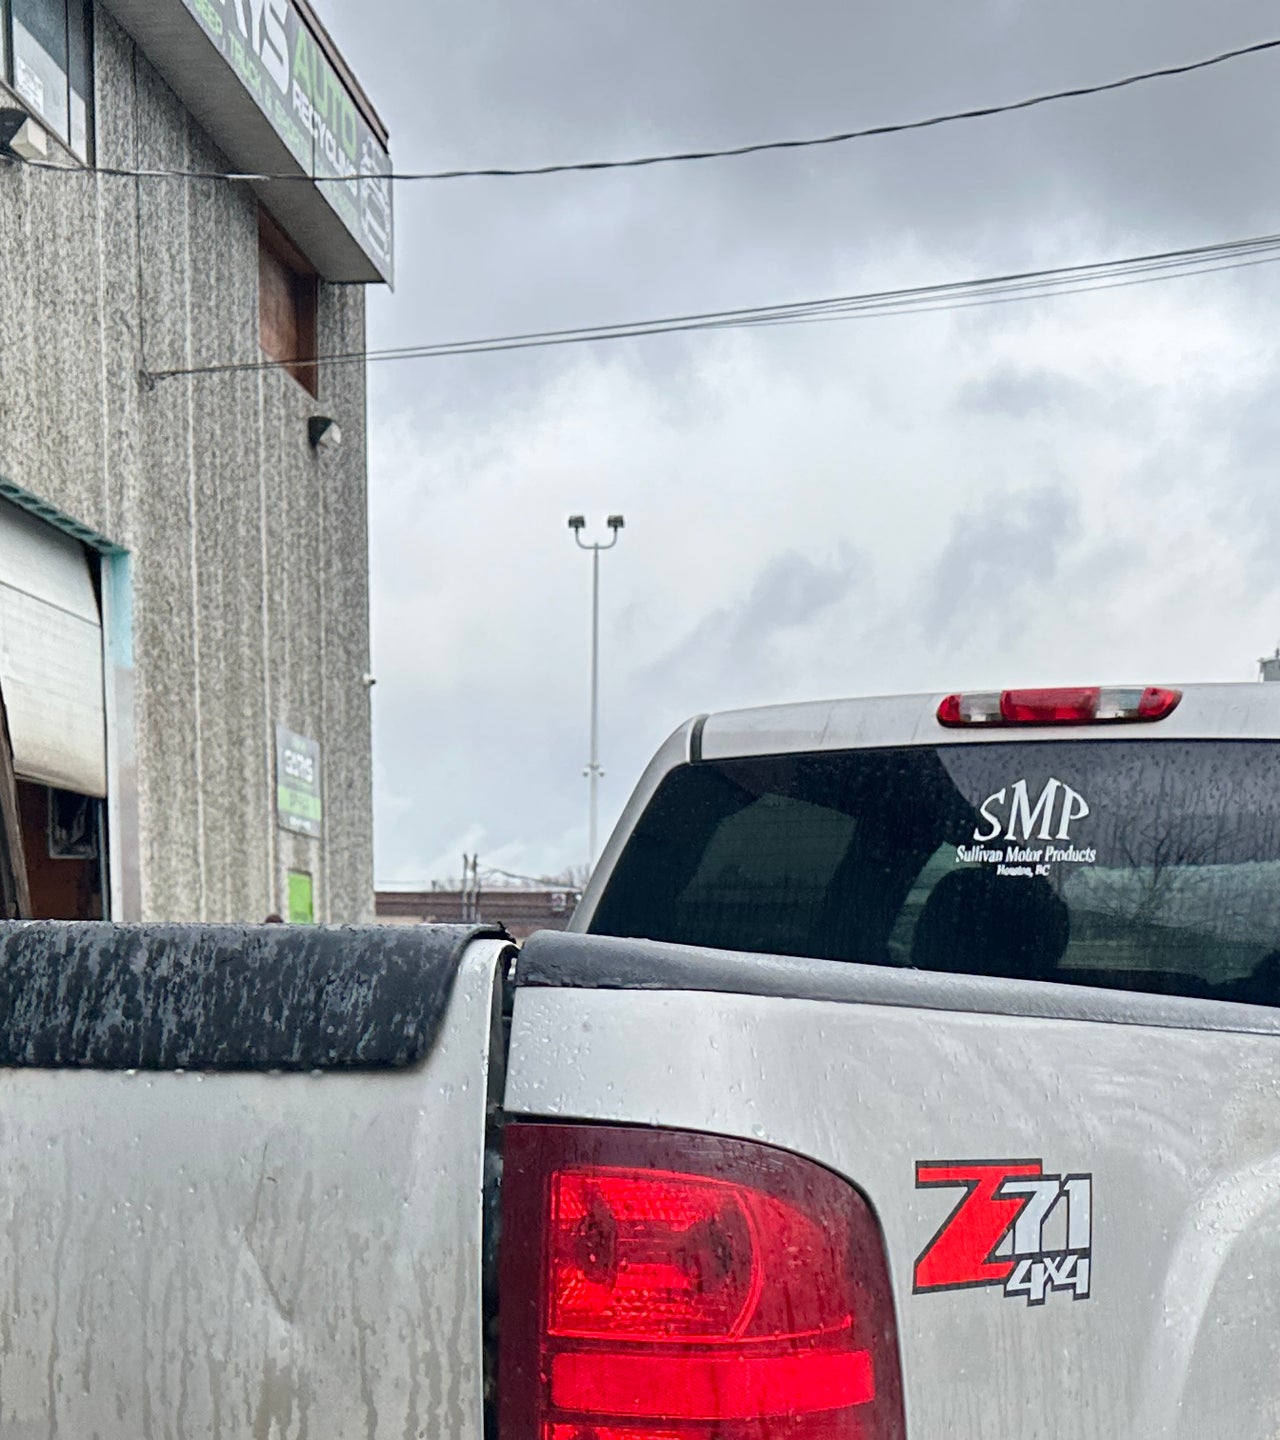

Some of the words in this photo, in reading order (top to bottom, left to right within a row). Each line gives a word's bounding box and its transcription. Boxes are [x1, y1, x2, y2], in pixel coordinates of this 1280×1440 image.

[222, 0, 290, 95] YS
[293, 25, 357, 163] AUTO
[292, 77, 359, 198] RECYCLING
[956, 845, 1003, 862] Sullivan
[1005, 846, 1042, 862] Motor
[1044, 845, 1096, 863] Products
[973, 777, 1090, 841] SMP
[913, 1158, 1092, 1294] Z71
